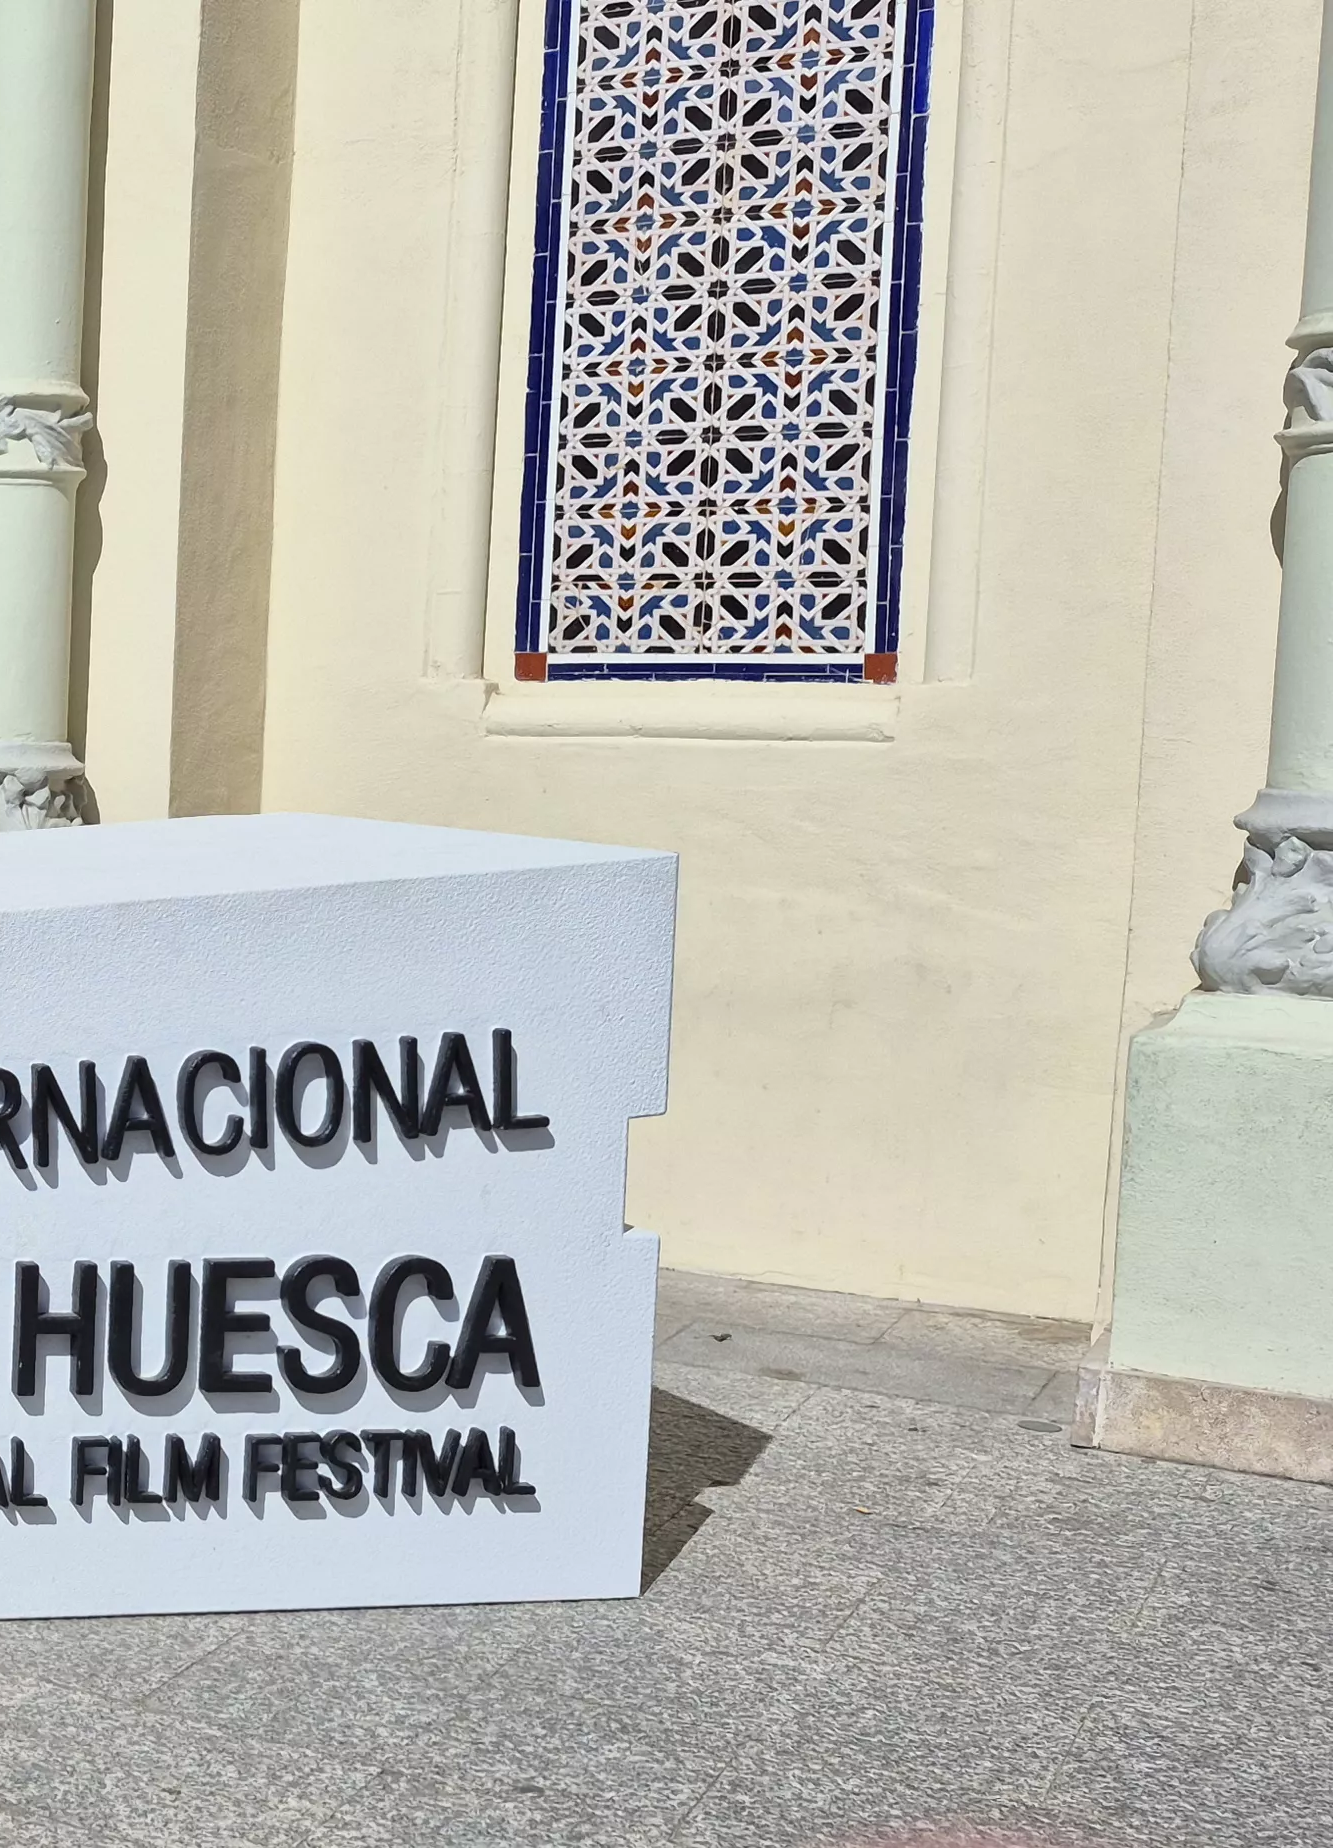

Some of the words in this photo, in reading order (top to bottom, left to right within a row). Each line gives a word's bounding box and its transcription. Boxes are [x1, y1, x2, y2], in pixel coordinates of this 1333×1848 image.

[13, 1255, 542, 1398] HUESCA
[71, 1433, 223, 1507] FILM
[243, 1426, 538, 1505] FESTIVAL
